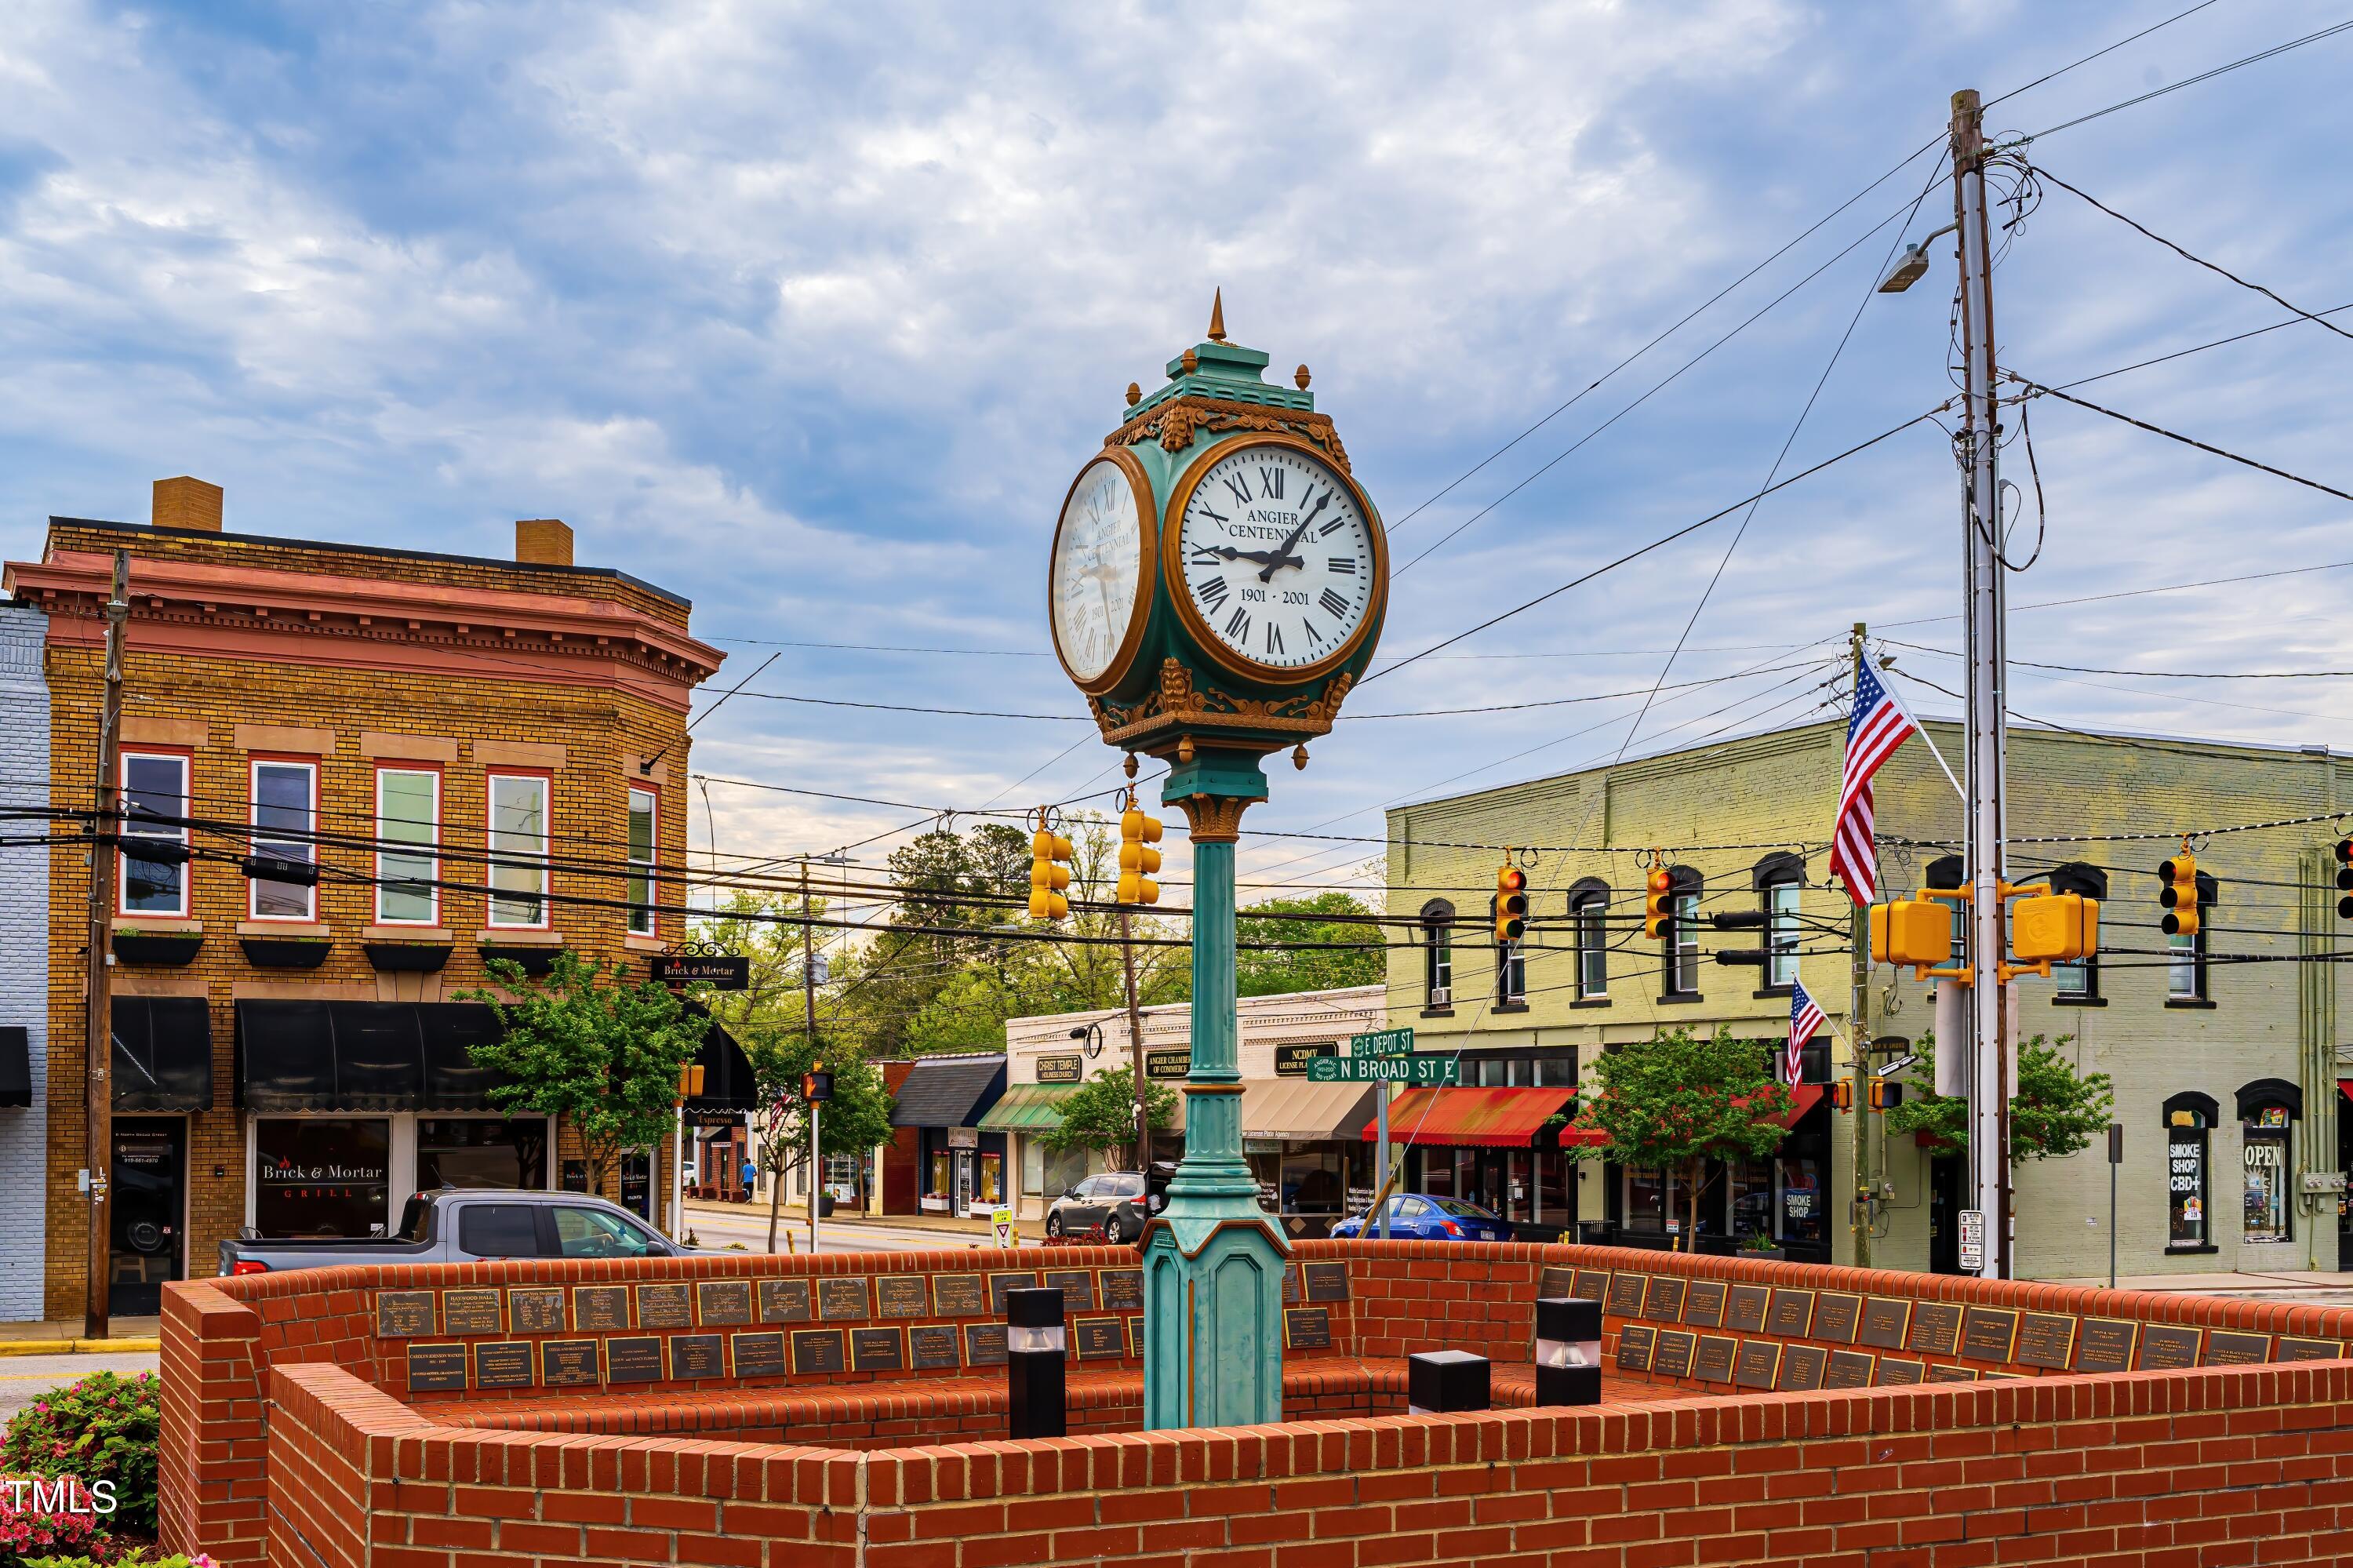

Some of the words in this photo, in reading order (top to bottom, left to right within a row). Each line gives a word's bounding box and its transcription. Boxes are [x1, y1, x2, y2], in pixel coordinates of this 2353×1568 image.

[1223, 471, 1253, 508] XI
[1260, 467, 1284, 500] XII
[1299, 483, 1314, 510] I
[1198, 501, 1229, 531] X
[1247, 510, 1300, 526] ANGIER
[1097, 520, 1122, 541] ANGIER
[1229, 524, 1318, 544] CENTENNAL
[1318, 515, 1344, 537] II
[1328, 558, 1355, 574] III
[1197, 576, 1230, 616] VIII
[1241, 589, 1266, 602] 1901
[1282, 591, 1310, 605] 2001
[1092, 606, 1104, 620] 1901
[1111, 597, 1124, 613] 2001
[1224, 606, 1251, 646] VII
[1303, 616, 1322, 647] V
[1267, 622, 1285, 655] VI
[664, 966, 689, 975] Brick
[702, 966, 735, 975] Mortar
[1366, 1038, 1370, 1054] E
[1373, 1033, 1397, 1053] DEPOT
[1401, 1031, 1410, 1050] ST
[1293, 1049, 1318, 1060] NCDMV
[1038, 1060, 1057, 1071] CHRIST
[1057, 1059, 1078, 1070] TEMPLE
[1341, 1060, 1351, 1078] N
[1358, 1060, 1409, 1078] BROAD
[1418, 1060, 1436, 1078] ST
[1445, 1060, 1454, 1078] E
[1323, 1072, 1337, 1081] YEARS
[697, 1115, 733, 1125] Espresso
[1275, 1130, 1290, 1139] Agency
[2169, 1144, 2200, 1158] SMOKE
[2245, 1145, 2281, 1166] OPEN
[263, 1165, 305, 1179] Brick
[311, 1167, 322, 1178] &
[328, 1165, 382, 1178] Mortar
[2172, 1159, 2197, 1173] SHOP
[2170, 1176, 2200, 1191] CBD+
[284, 1188, 351, 1198] GRILL
[1787, 1195, 1811, 1206] SMOKE
[1789, 1206, 1809, 1217] SHOP
